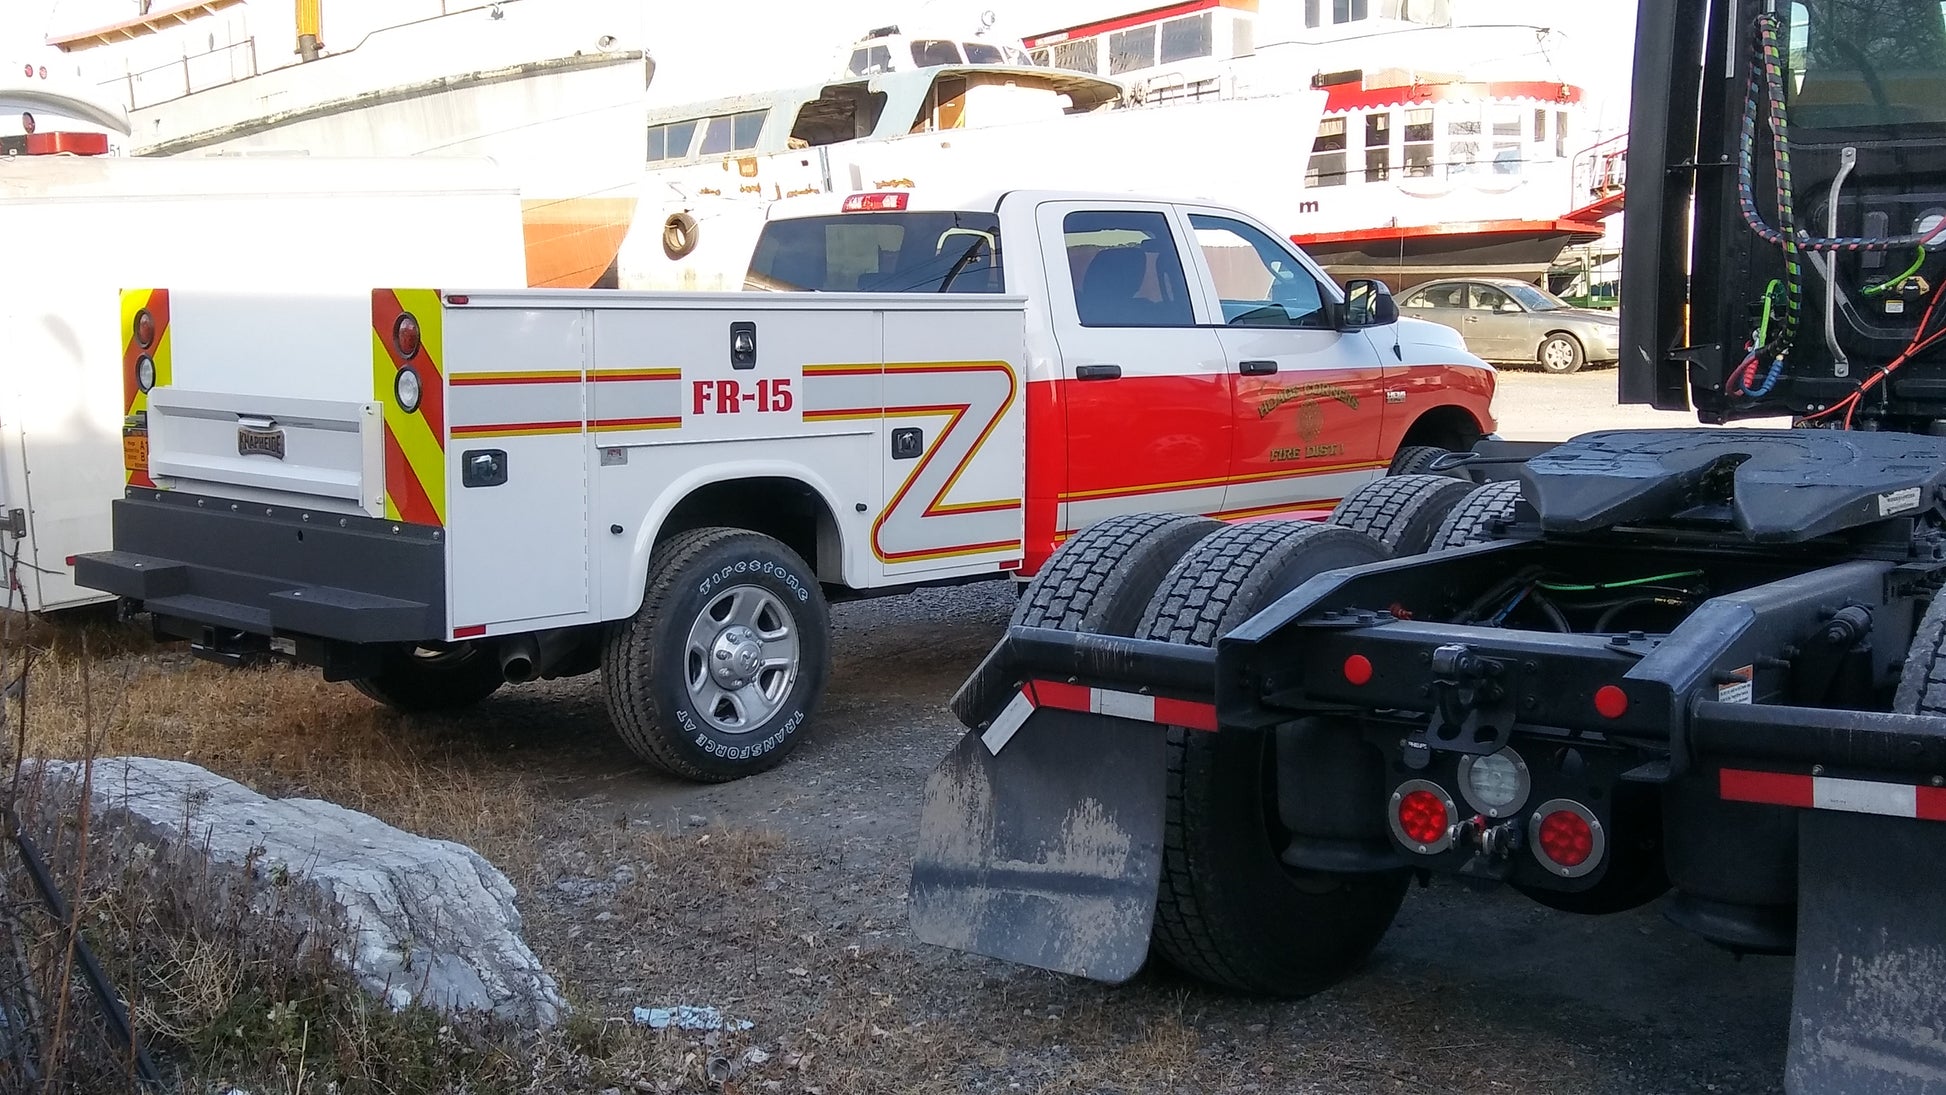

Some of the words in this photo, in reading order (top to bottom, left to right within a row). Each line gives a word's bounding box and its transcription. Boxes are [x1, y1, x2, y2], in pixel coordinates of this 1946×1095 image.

[693, 379, 793, 415] FR-15
[1270, 448, 1300, 462] FIRE
[699, 560, 808, 602] Firestone
[676, 710, 697, 732] AT
[695, 710, 805, 759] TRANSFORCE
